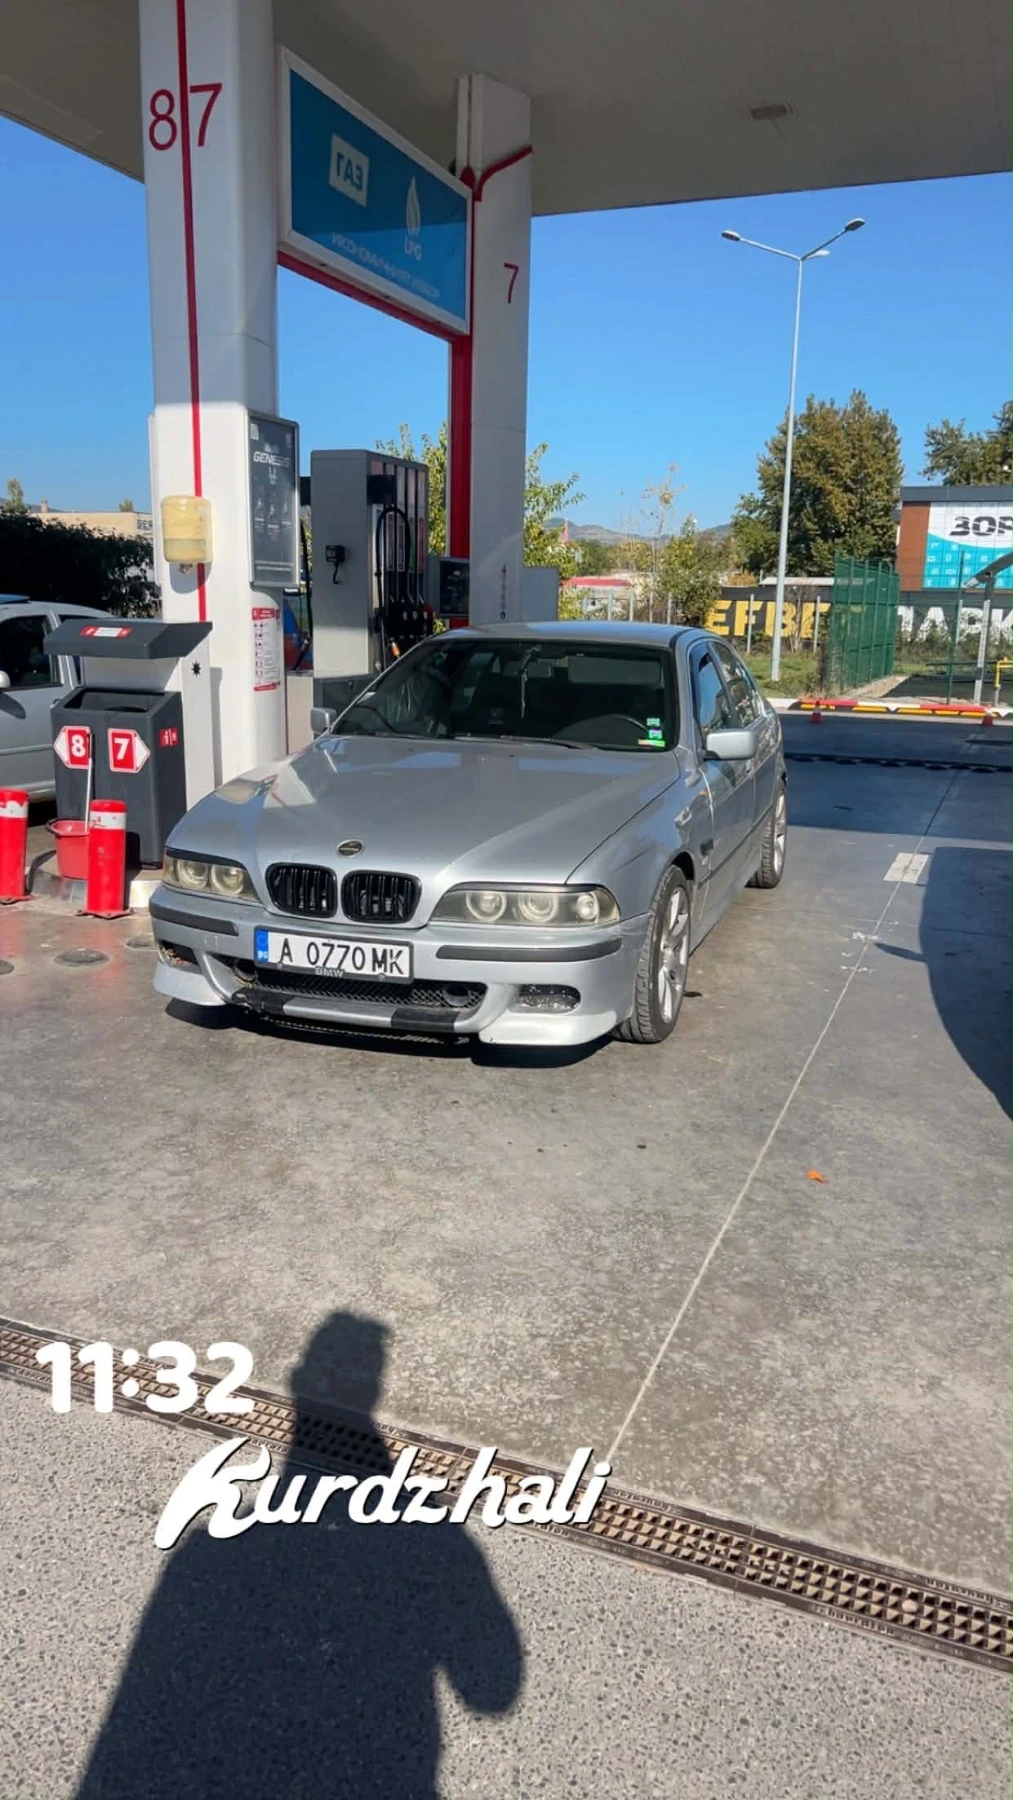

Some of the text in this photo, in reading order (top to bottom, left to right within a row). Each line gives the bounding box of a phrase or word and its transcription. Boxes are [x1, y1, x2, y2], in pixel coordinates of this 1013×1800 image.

[149, 83, 222, 151] 8 7
[336, 150, 364, 192] ГАЗ
[404, 236, 423, 261] LPG
[503, 262, 520, 304] 7
[253, 450, 291, 468] GENESIS
[71, 735, 128, 760] 8 7
[279, 937, 294, 964] A
[306, 941, 366, 971] 0770
[371, 947, 405, 975] MK
[314, 965, 344, 977] BMW
